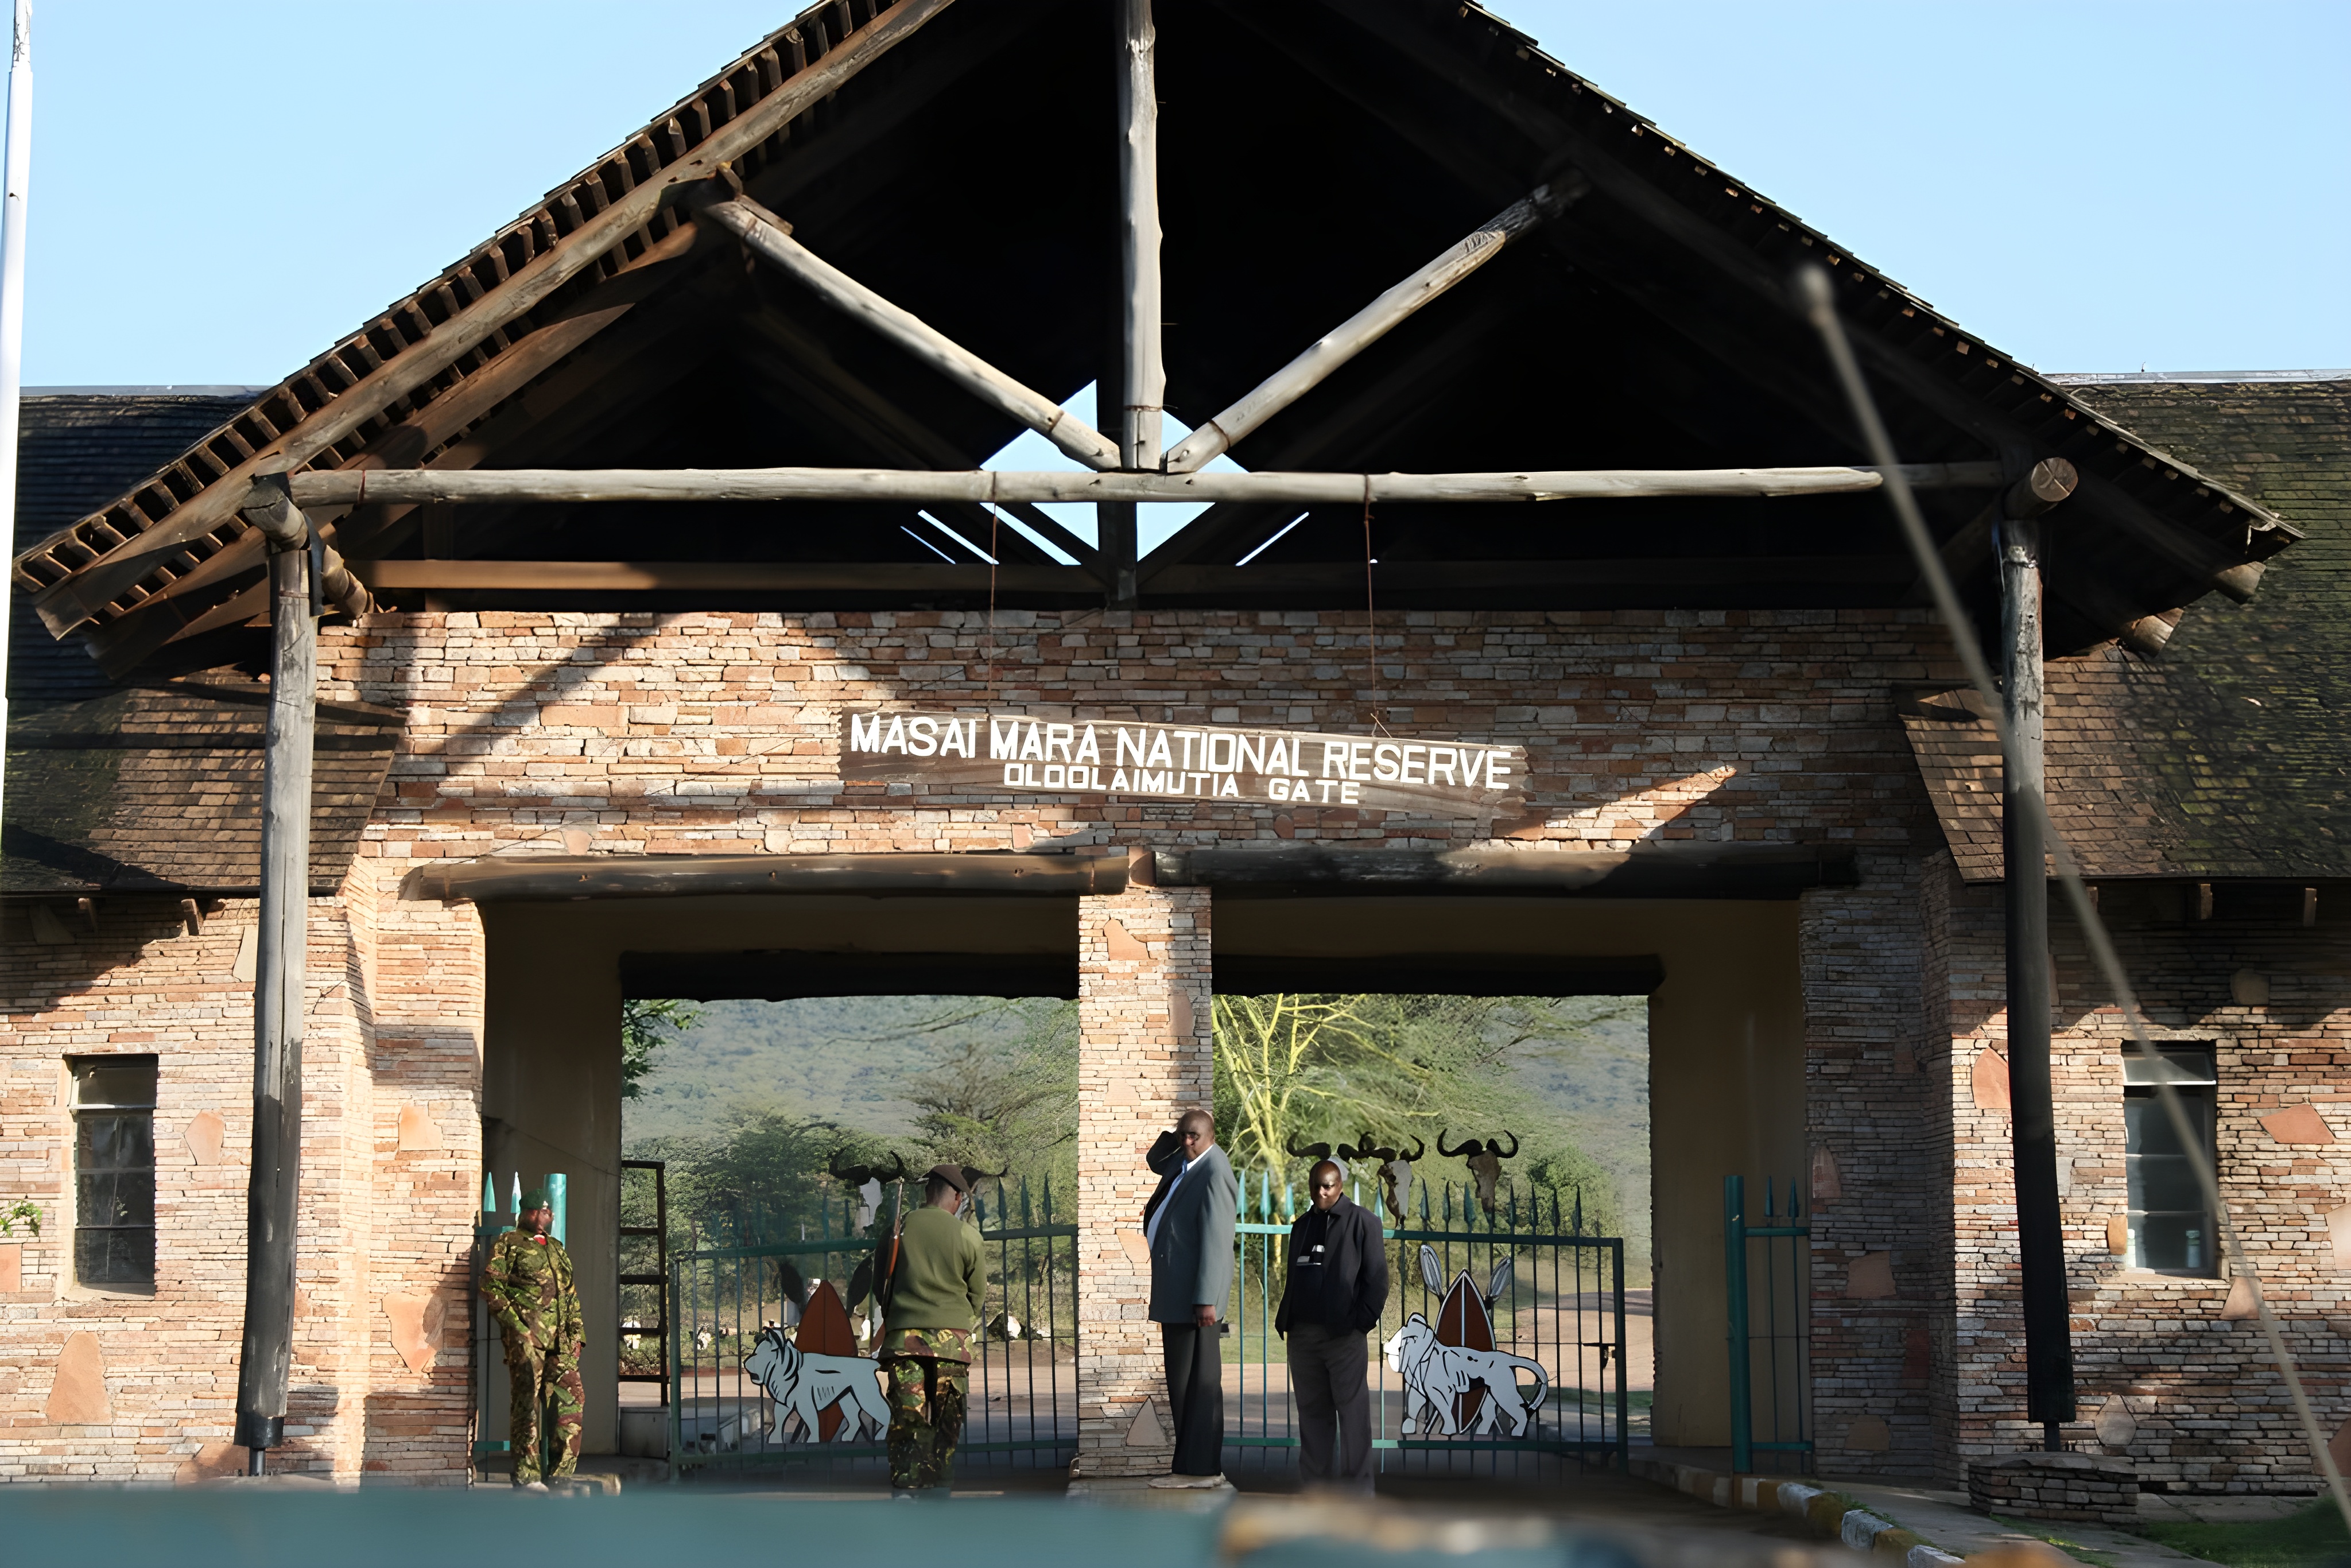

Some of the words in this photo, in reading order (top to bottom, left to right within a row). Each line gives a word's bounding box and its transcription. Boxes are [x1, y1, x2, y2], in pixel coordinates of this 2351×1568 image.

[851, 713, 976, 759] MASAI
[990, 719, 1100, 765] MARA
[1116, 726, 1309, 777] NATIONAL
[1322, 740, 1512, 790] RESERVE
[1004, 763, 1239, 797] OLOOLAIMUTIA
[1268, 778, 1361, 805] GATE
